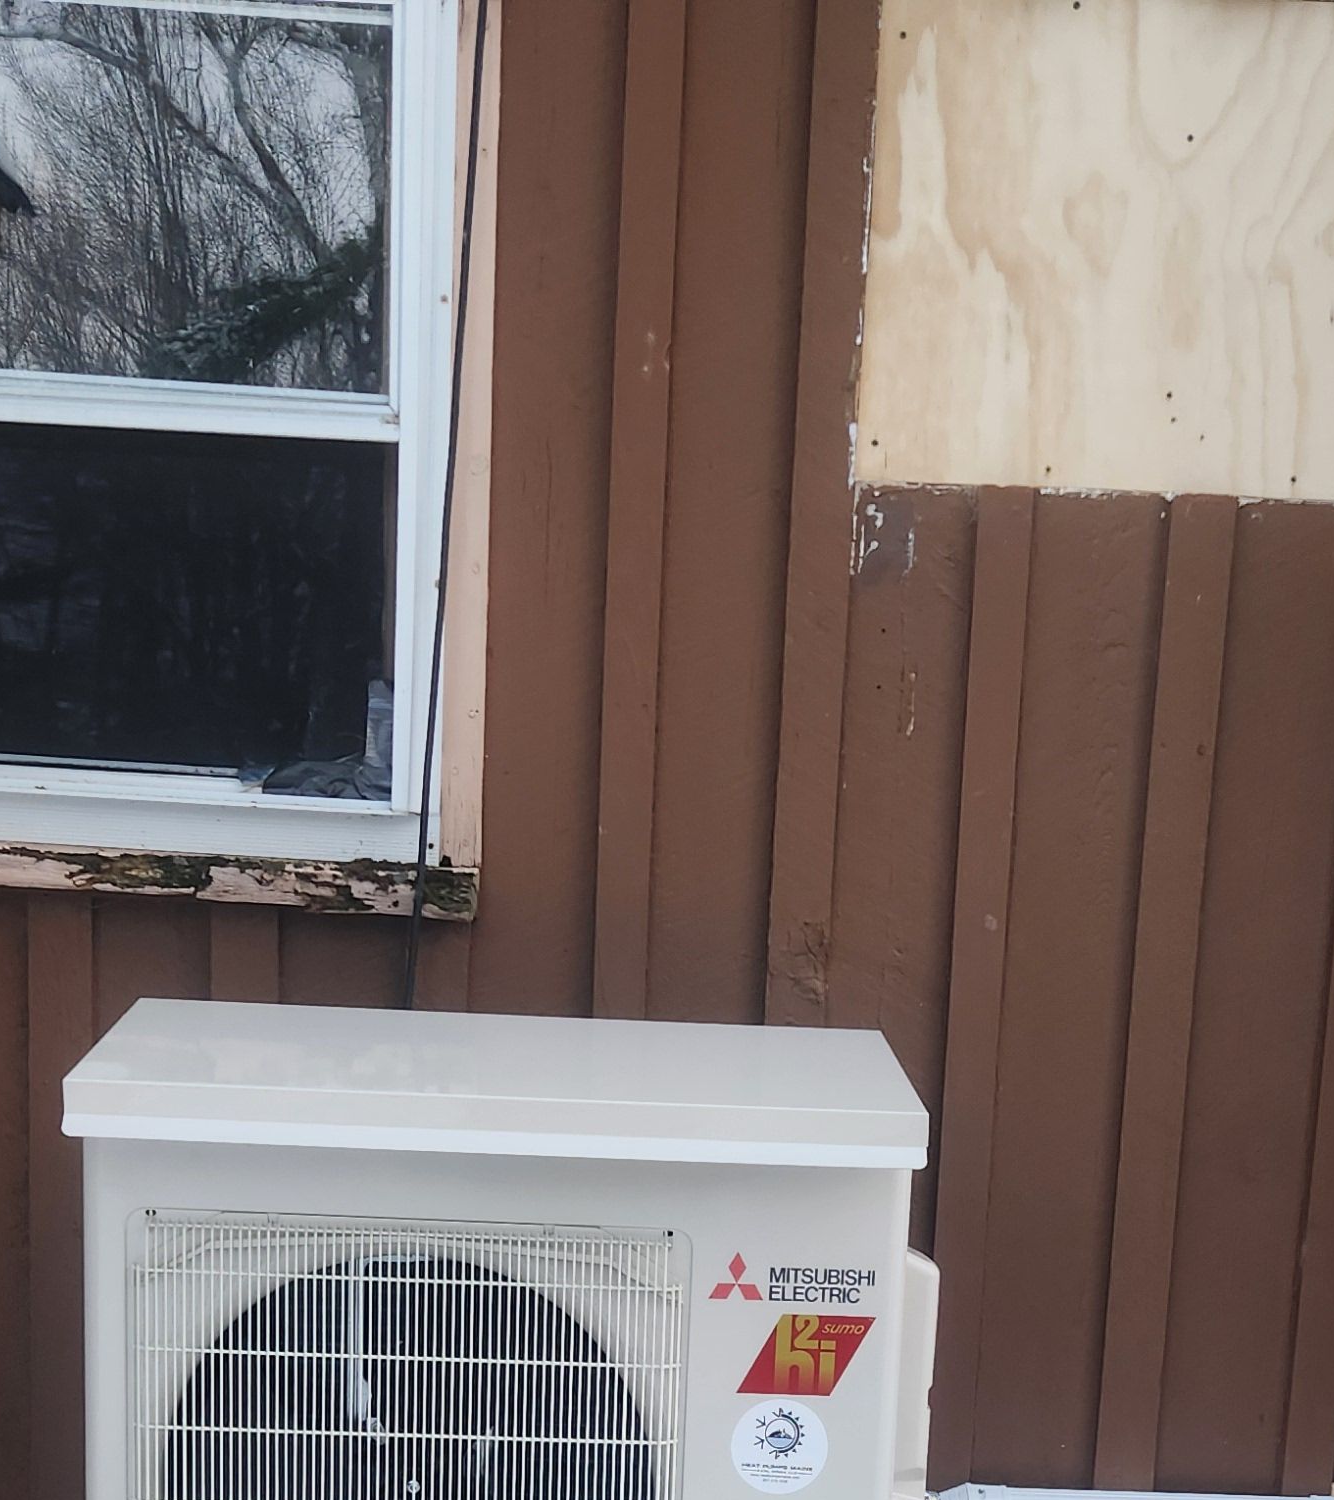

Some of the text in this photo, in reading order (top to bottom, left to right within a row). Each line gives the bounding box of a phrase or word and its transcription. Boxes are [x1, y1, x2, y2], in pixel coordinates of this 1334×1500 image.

[769, 1267, 876, 1286] MITSUBISHI
[768, 1285, 861, 1303] ELECTRIC
[821, 1322, 865, 1335] sumo
